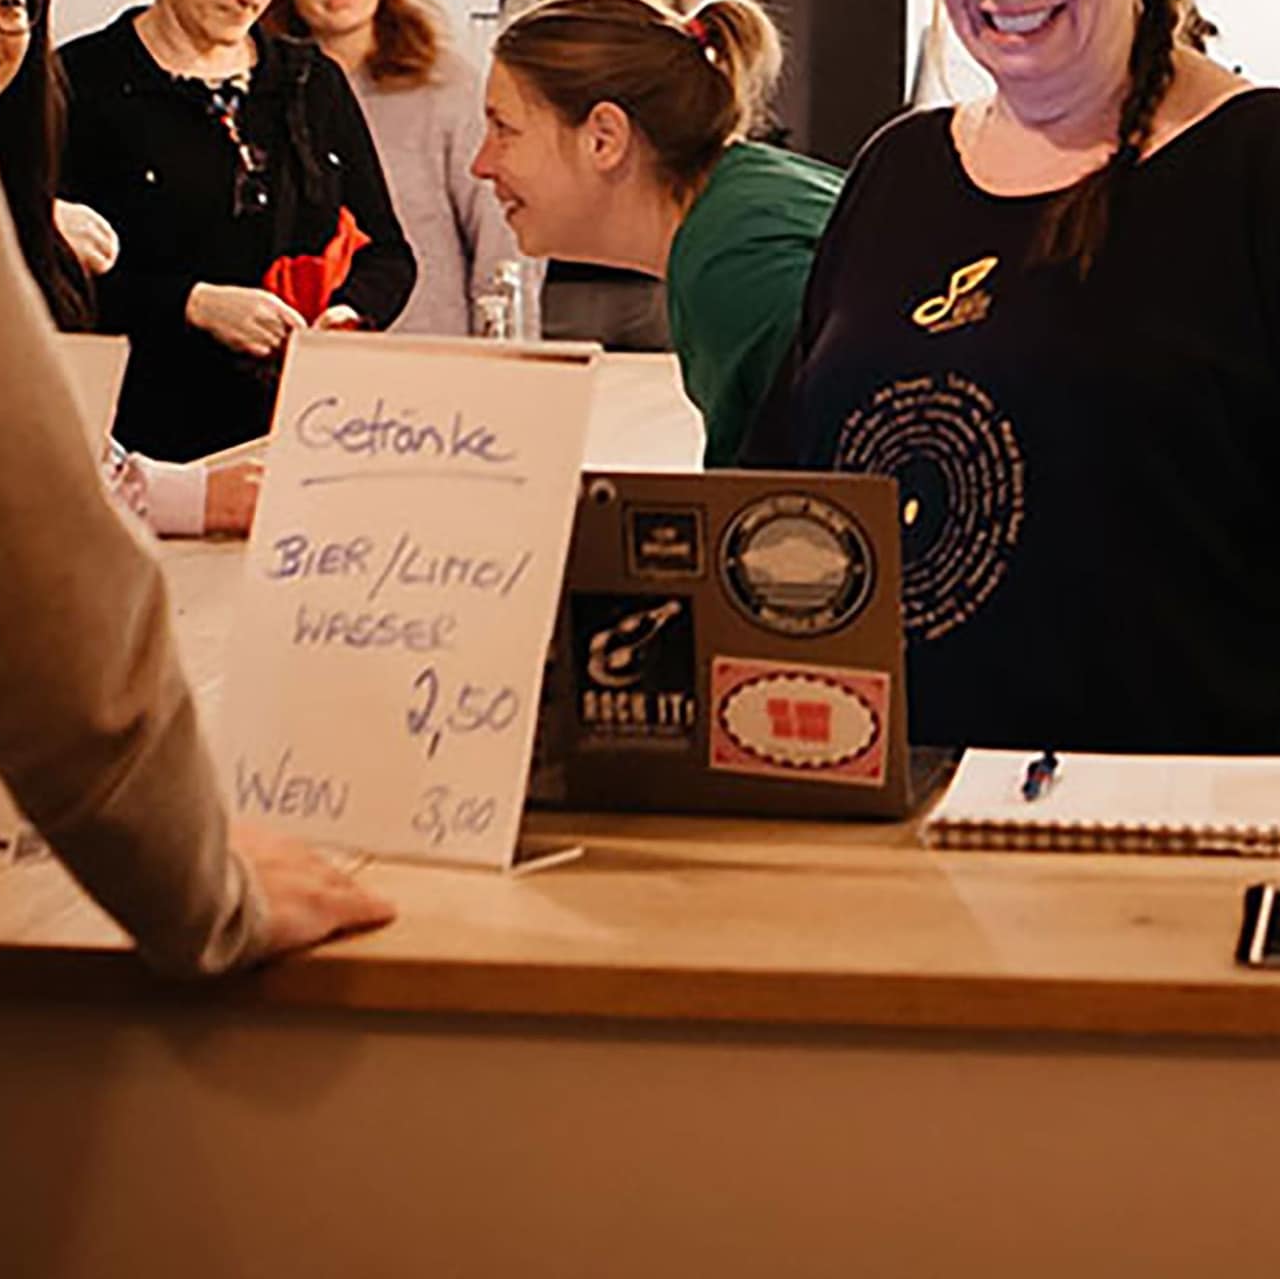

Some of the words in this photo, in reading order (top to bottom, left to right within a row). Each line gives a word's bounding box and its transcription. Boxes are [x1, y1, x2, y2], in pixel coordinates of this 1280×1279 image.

[296, 396, 518, 462] Getränke
[292, 605, 458, 651] WASSER
[407, 667, 519, 760] 2,50
[411, 784, 497, 844] 3,00
